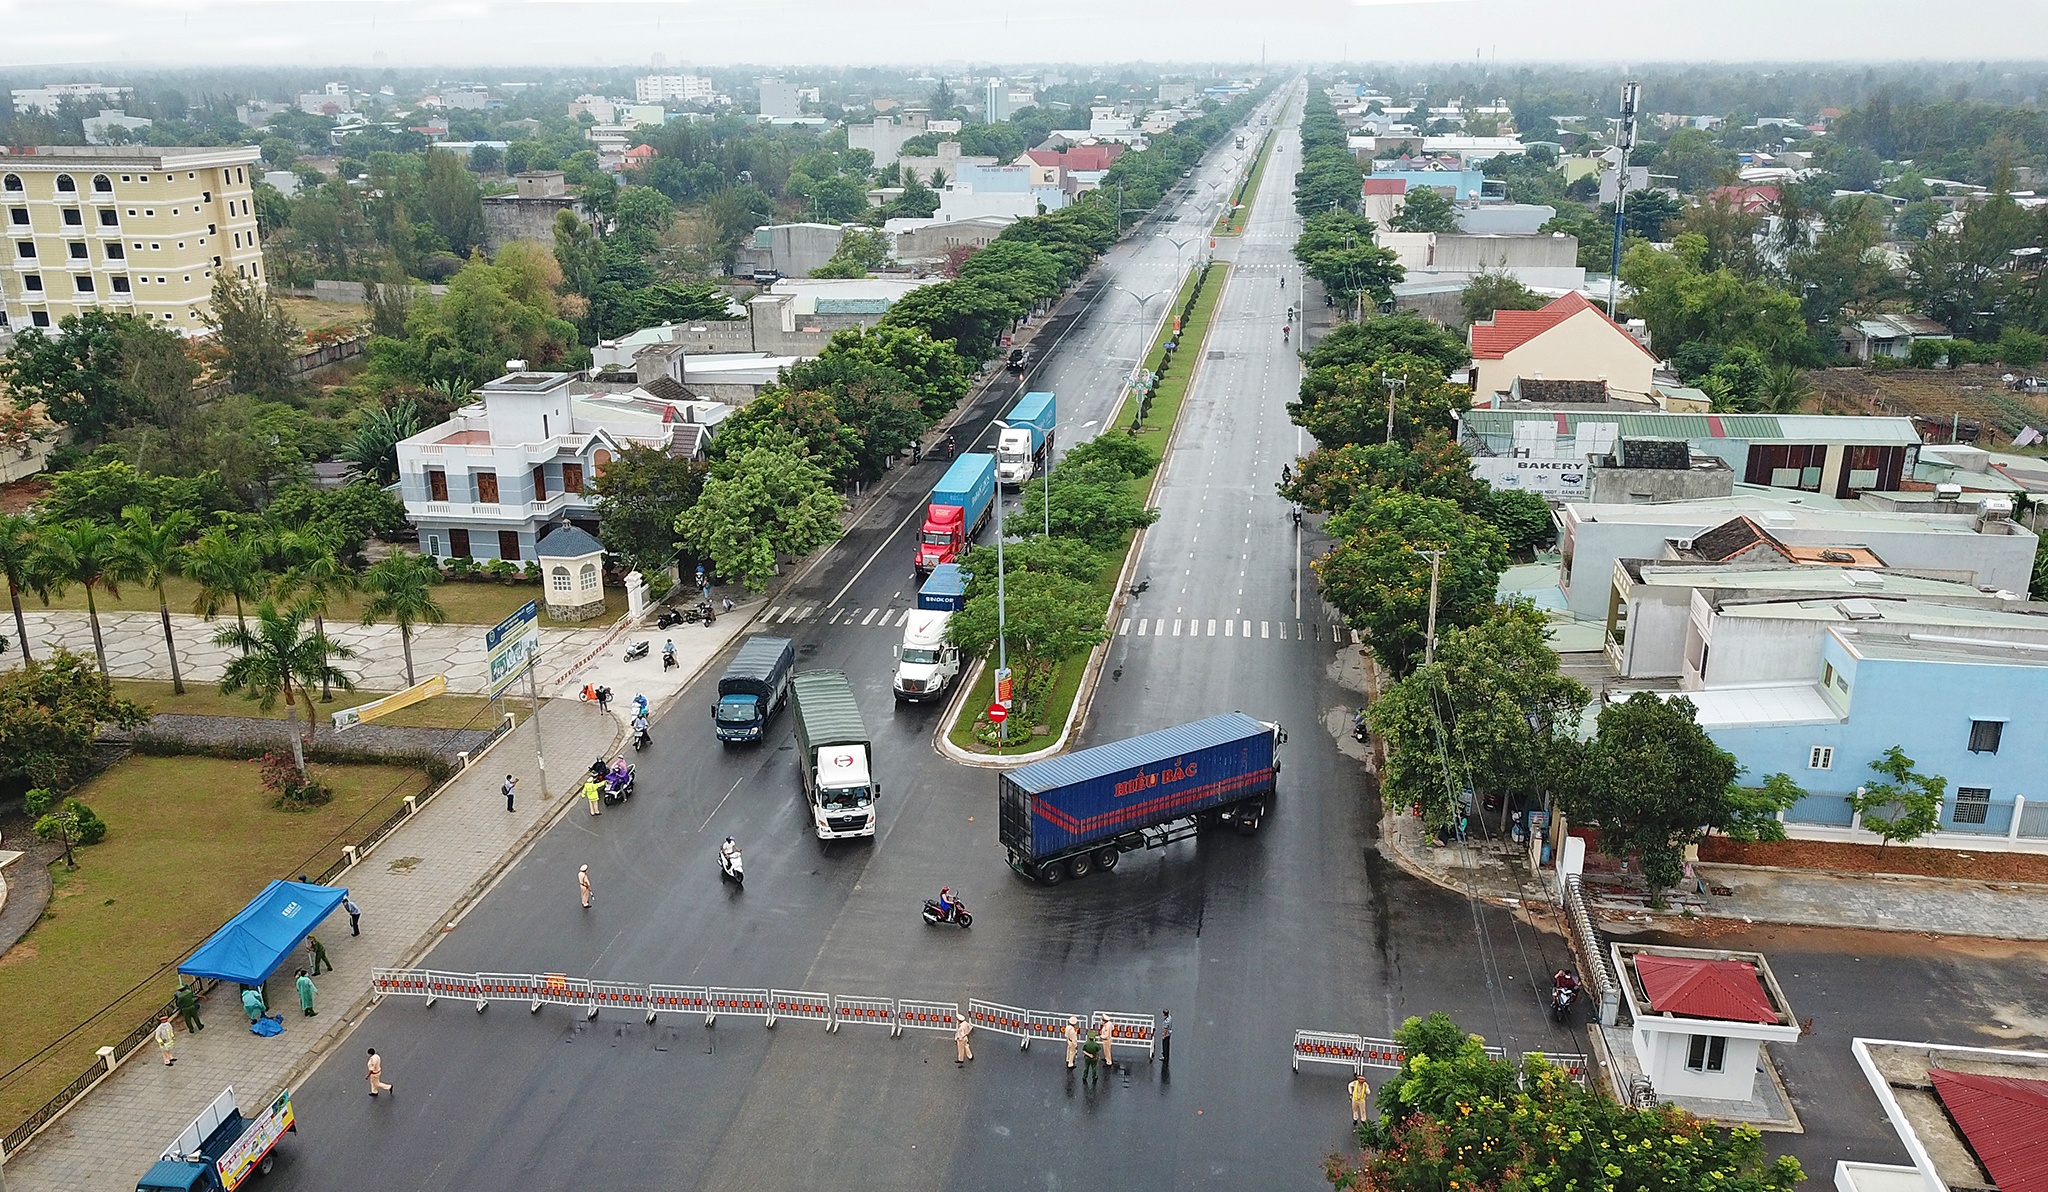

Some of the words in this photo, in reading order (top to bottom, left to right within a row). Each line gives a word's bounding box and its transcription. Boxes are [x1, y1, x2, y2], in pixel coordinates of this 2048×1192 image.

[1518, 462, 1584, 470] BAKERY
[1114, 767, 1158, 797] HIẾU
[1162, 757, 1197, 784] BẮC
[380, 980, 423, 988] CSGT
[434, 983, 475, 993] CSGT
[485, 985, 527, 993] CSGT
[542, 987, 583, 999] CSGT
[599, 992, 642, 1002] CSGT
[658, 997, 702, 1006] CSGT
[718, 1000, 762, 1009] CSGT
[779, 1003, 823, 1013] CSGT
[842, 1007, 887, 1018] CSGT
[906, 1012, 951, 1023] CSGT
[976, 1014, 1020, 1028] CSGT
[1304, 1044, 1353, 1057] CSGT
